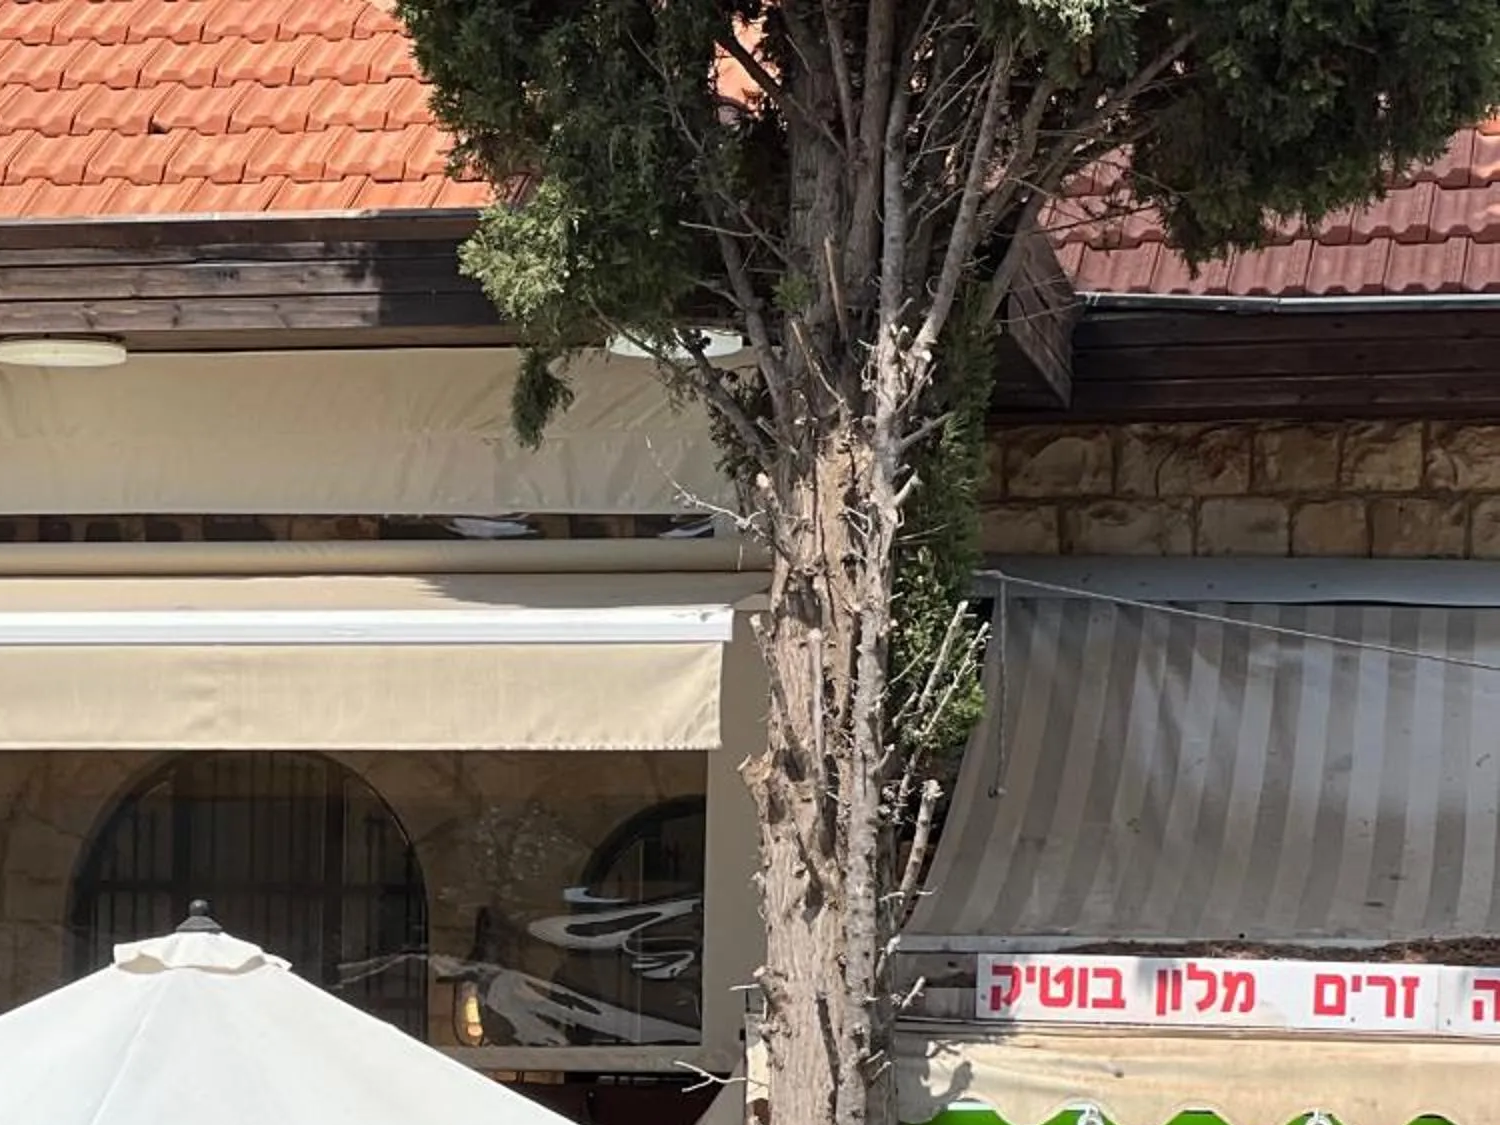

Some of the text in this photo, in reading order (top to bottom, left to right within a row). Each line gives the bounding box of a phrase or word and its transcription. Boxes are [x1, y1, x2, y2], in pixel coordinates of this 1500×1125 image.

[990, 963, 1126, 1012] בוטיק
[1156, 962, 1256, 1016] מלון
[1313, 973, 1420, 1019] זרים
